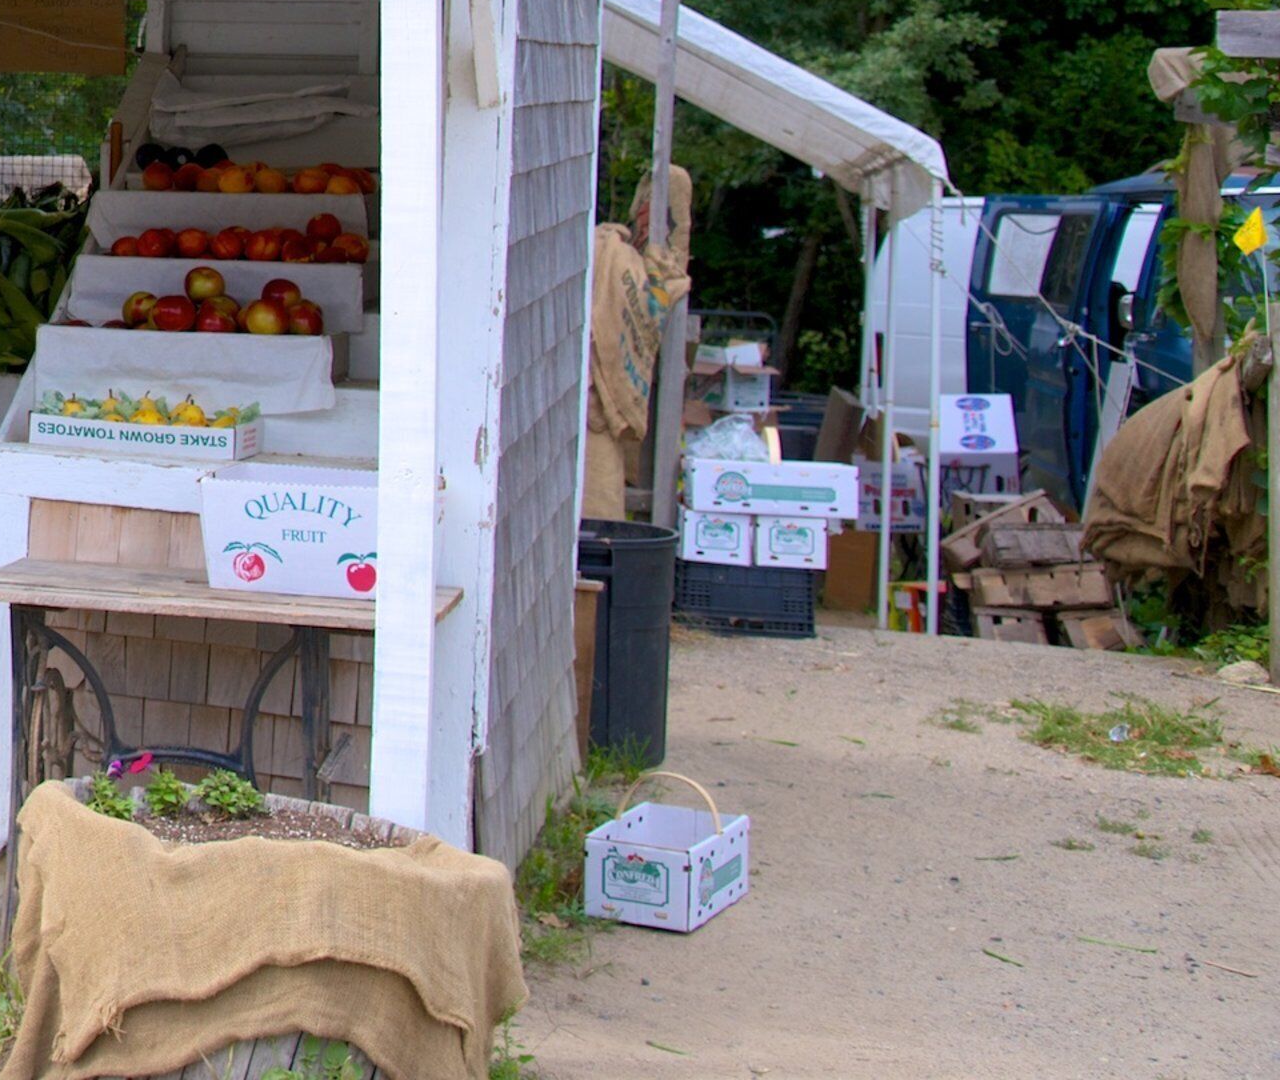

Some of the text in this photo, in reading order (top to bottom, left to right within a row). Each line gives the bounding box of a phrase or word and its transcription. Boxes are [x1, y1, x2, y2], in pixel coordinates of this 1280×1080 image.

[38, 422, 116, 440] TOMATOES
[120, 431, 176, 445] GROWN
[180, 435, 228, 448] STAKE
[244, 492, 362, 528] QUALITY
[282, 529, 327, 543] FRUIT
